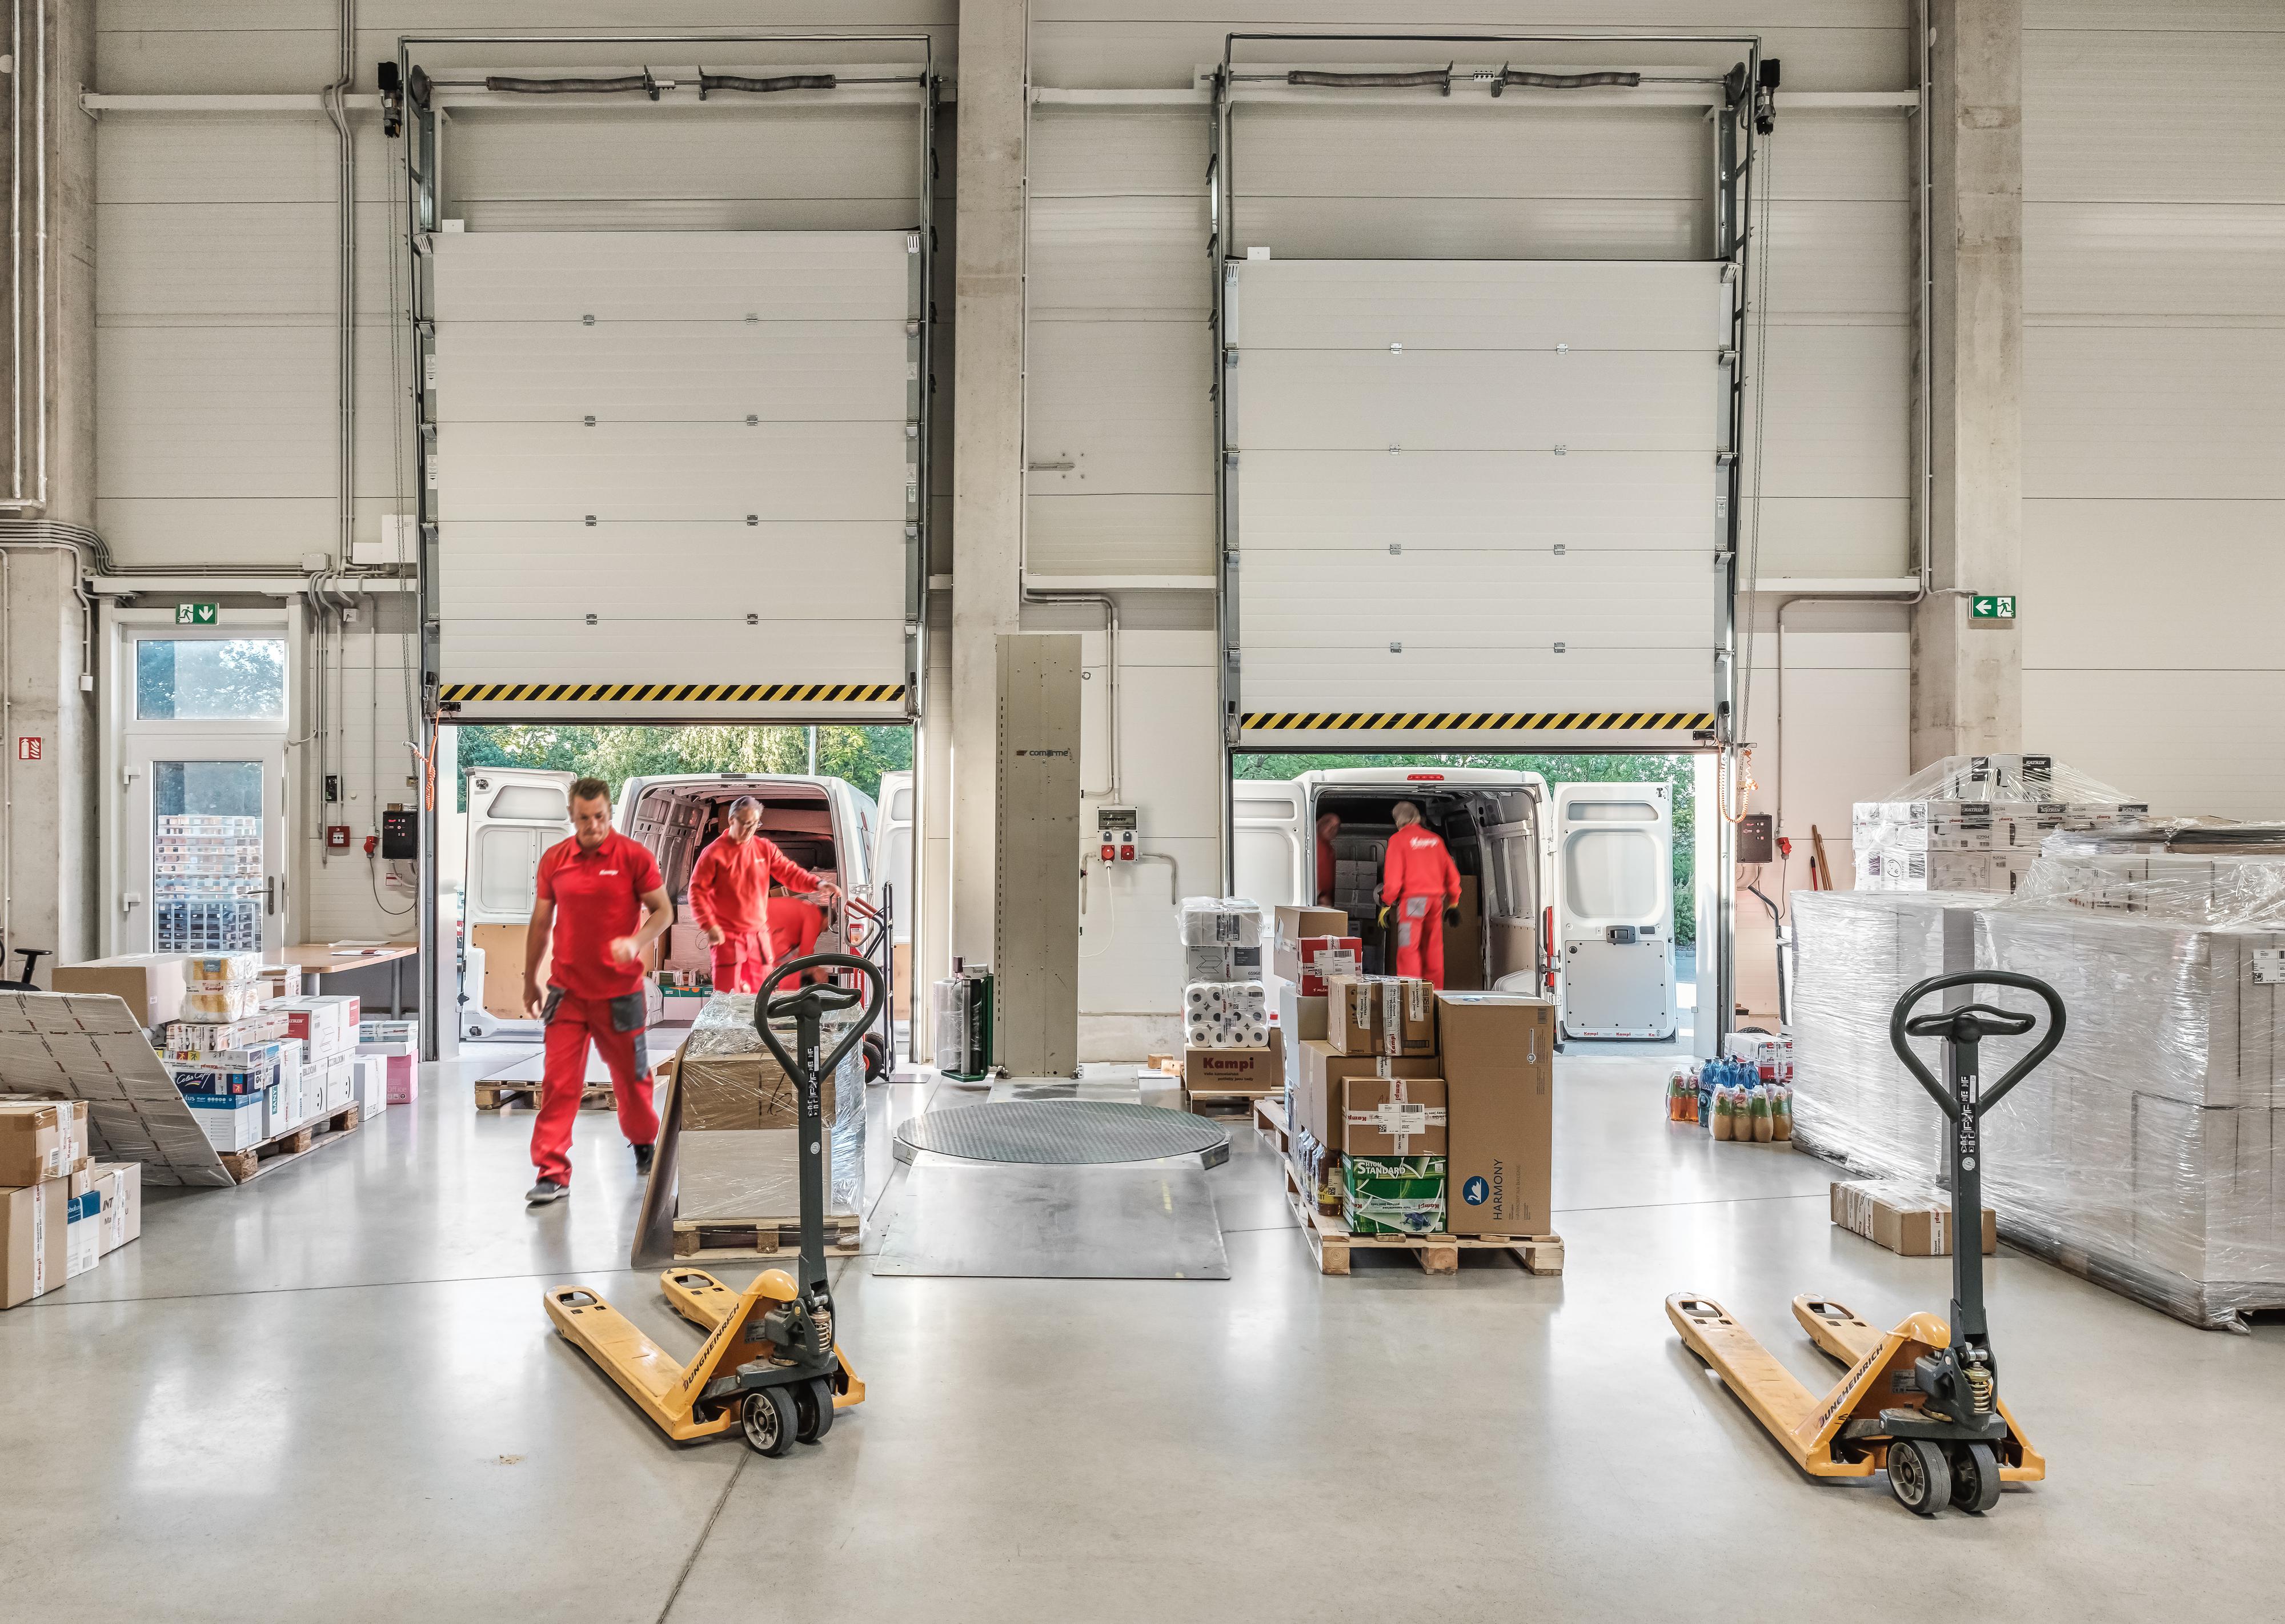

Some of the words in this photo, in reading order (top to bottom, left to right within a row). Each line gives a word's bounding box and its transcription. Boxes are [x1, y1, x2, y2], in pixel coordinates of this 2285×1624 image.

[177, 1074, 194, 1084] Color
[1203, 1057, 1254, 1072] Kampi
[1357, 1162, 1406, 1174] STANDARD
[1493, 1158, 1503, 1220] HARMONY
[683, 1302, 740, 1392] JUNGHEINRICH
[1819, 1343, 1883, 1429] JUNGHEINRICH
